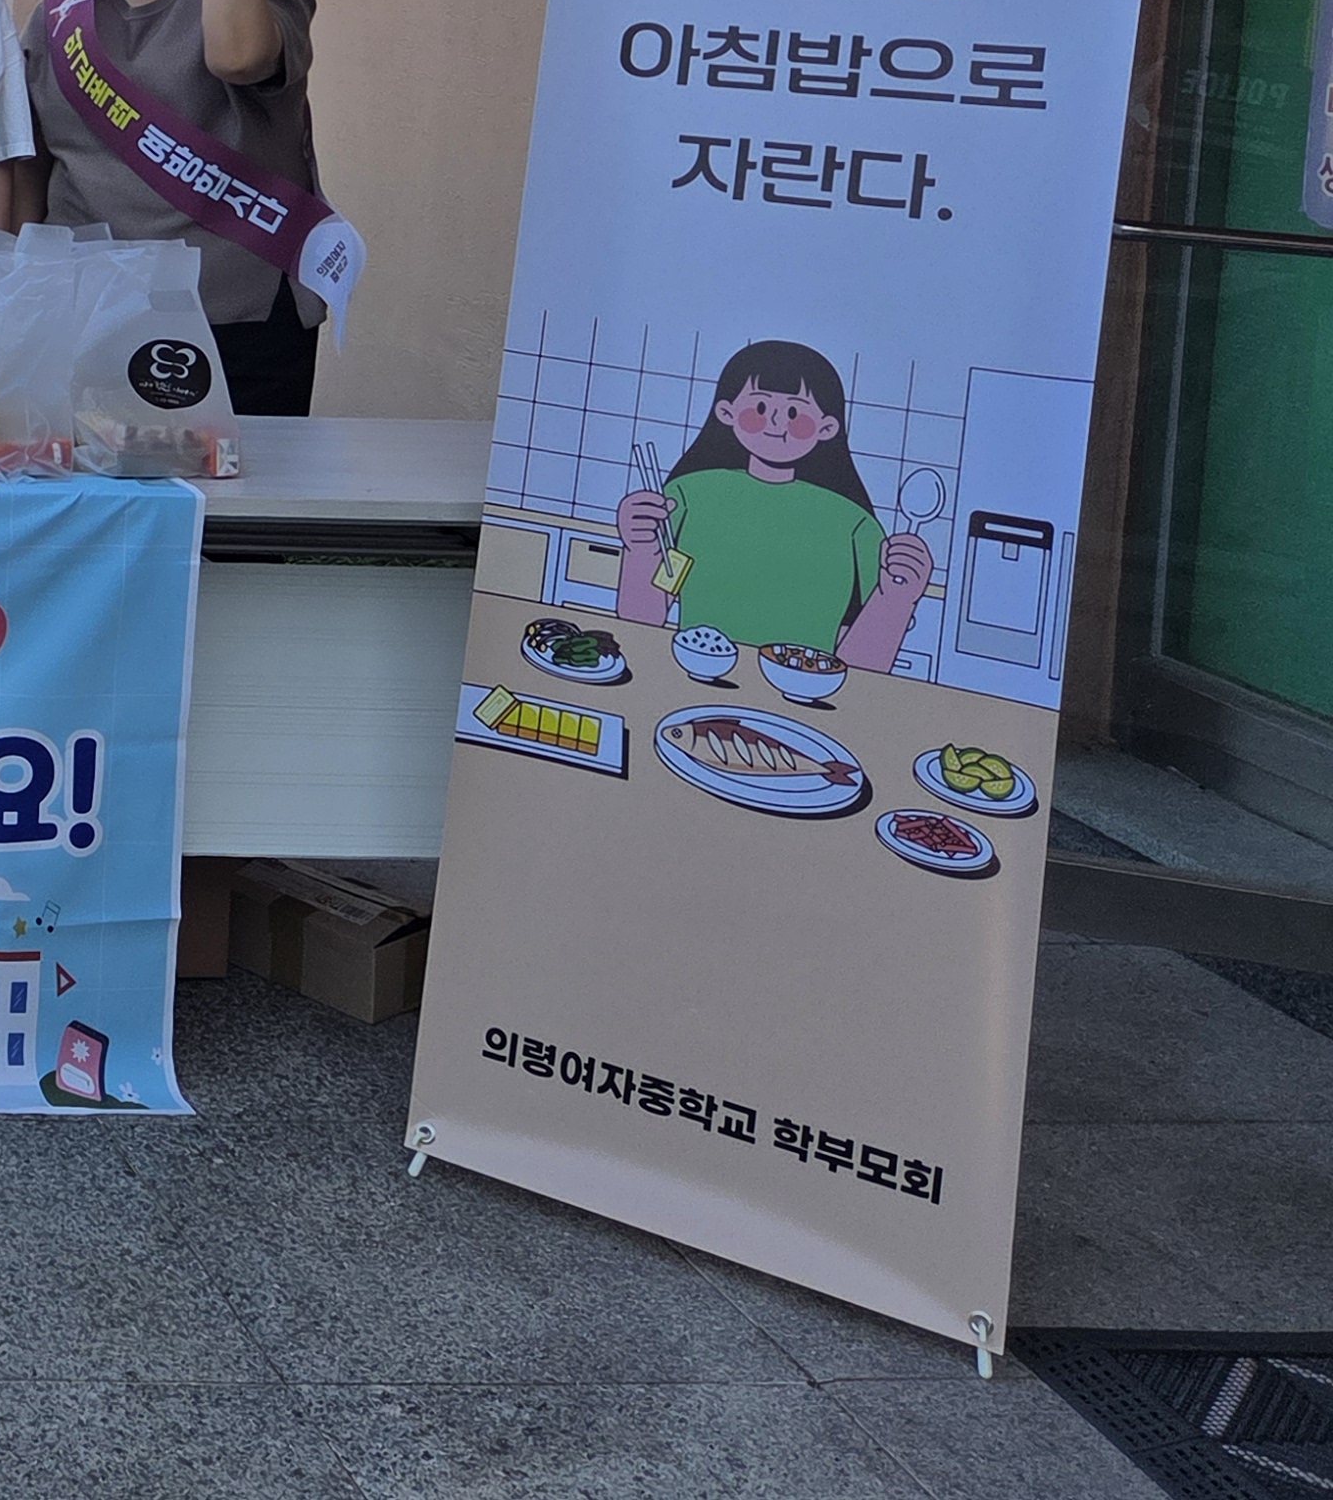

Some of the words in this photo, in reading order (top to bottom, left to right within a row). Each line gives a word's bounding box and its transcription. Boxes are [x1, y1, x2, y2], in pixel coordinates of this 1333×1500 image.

[63, 26, 141, 131] 학교폭력
[137, 123, 289, 235] 예방합시다
[618, 21, 1048, 111] 아침밥으로
[671, 133, 954, 222] 자란다.
[481, 1027, 757, 1145] 의령여자중학교
[773, 1118, 944, 1205] 학부모회
